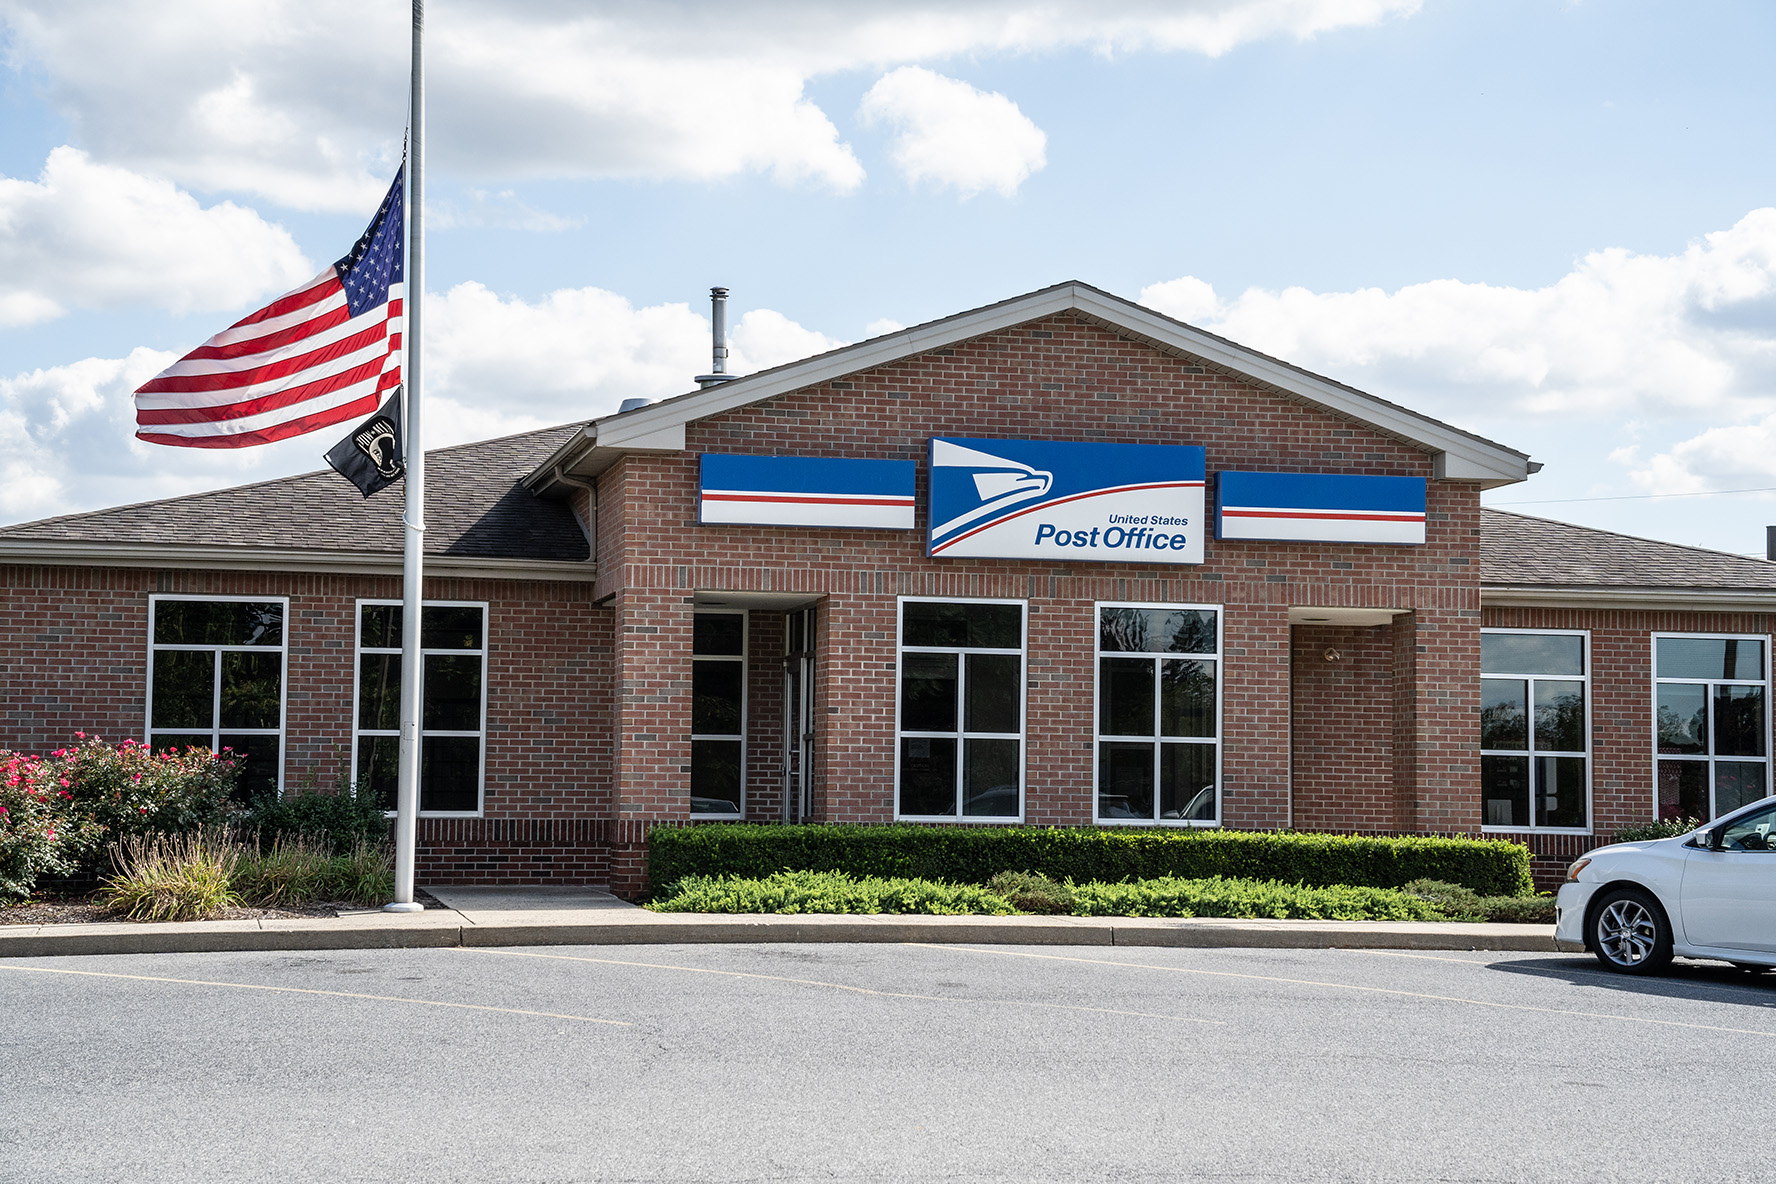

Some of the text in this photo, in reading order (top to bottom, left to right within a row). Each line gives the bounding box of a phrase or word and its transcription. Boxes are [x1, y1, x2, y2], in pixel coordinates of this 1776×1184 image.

[1109, 514, 1189, 526] United States
[1034, 523, 1187, 551] Post Office
